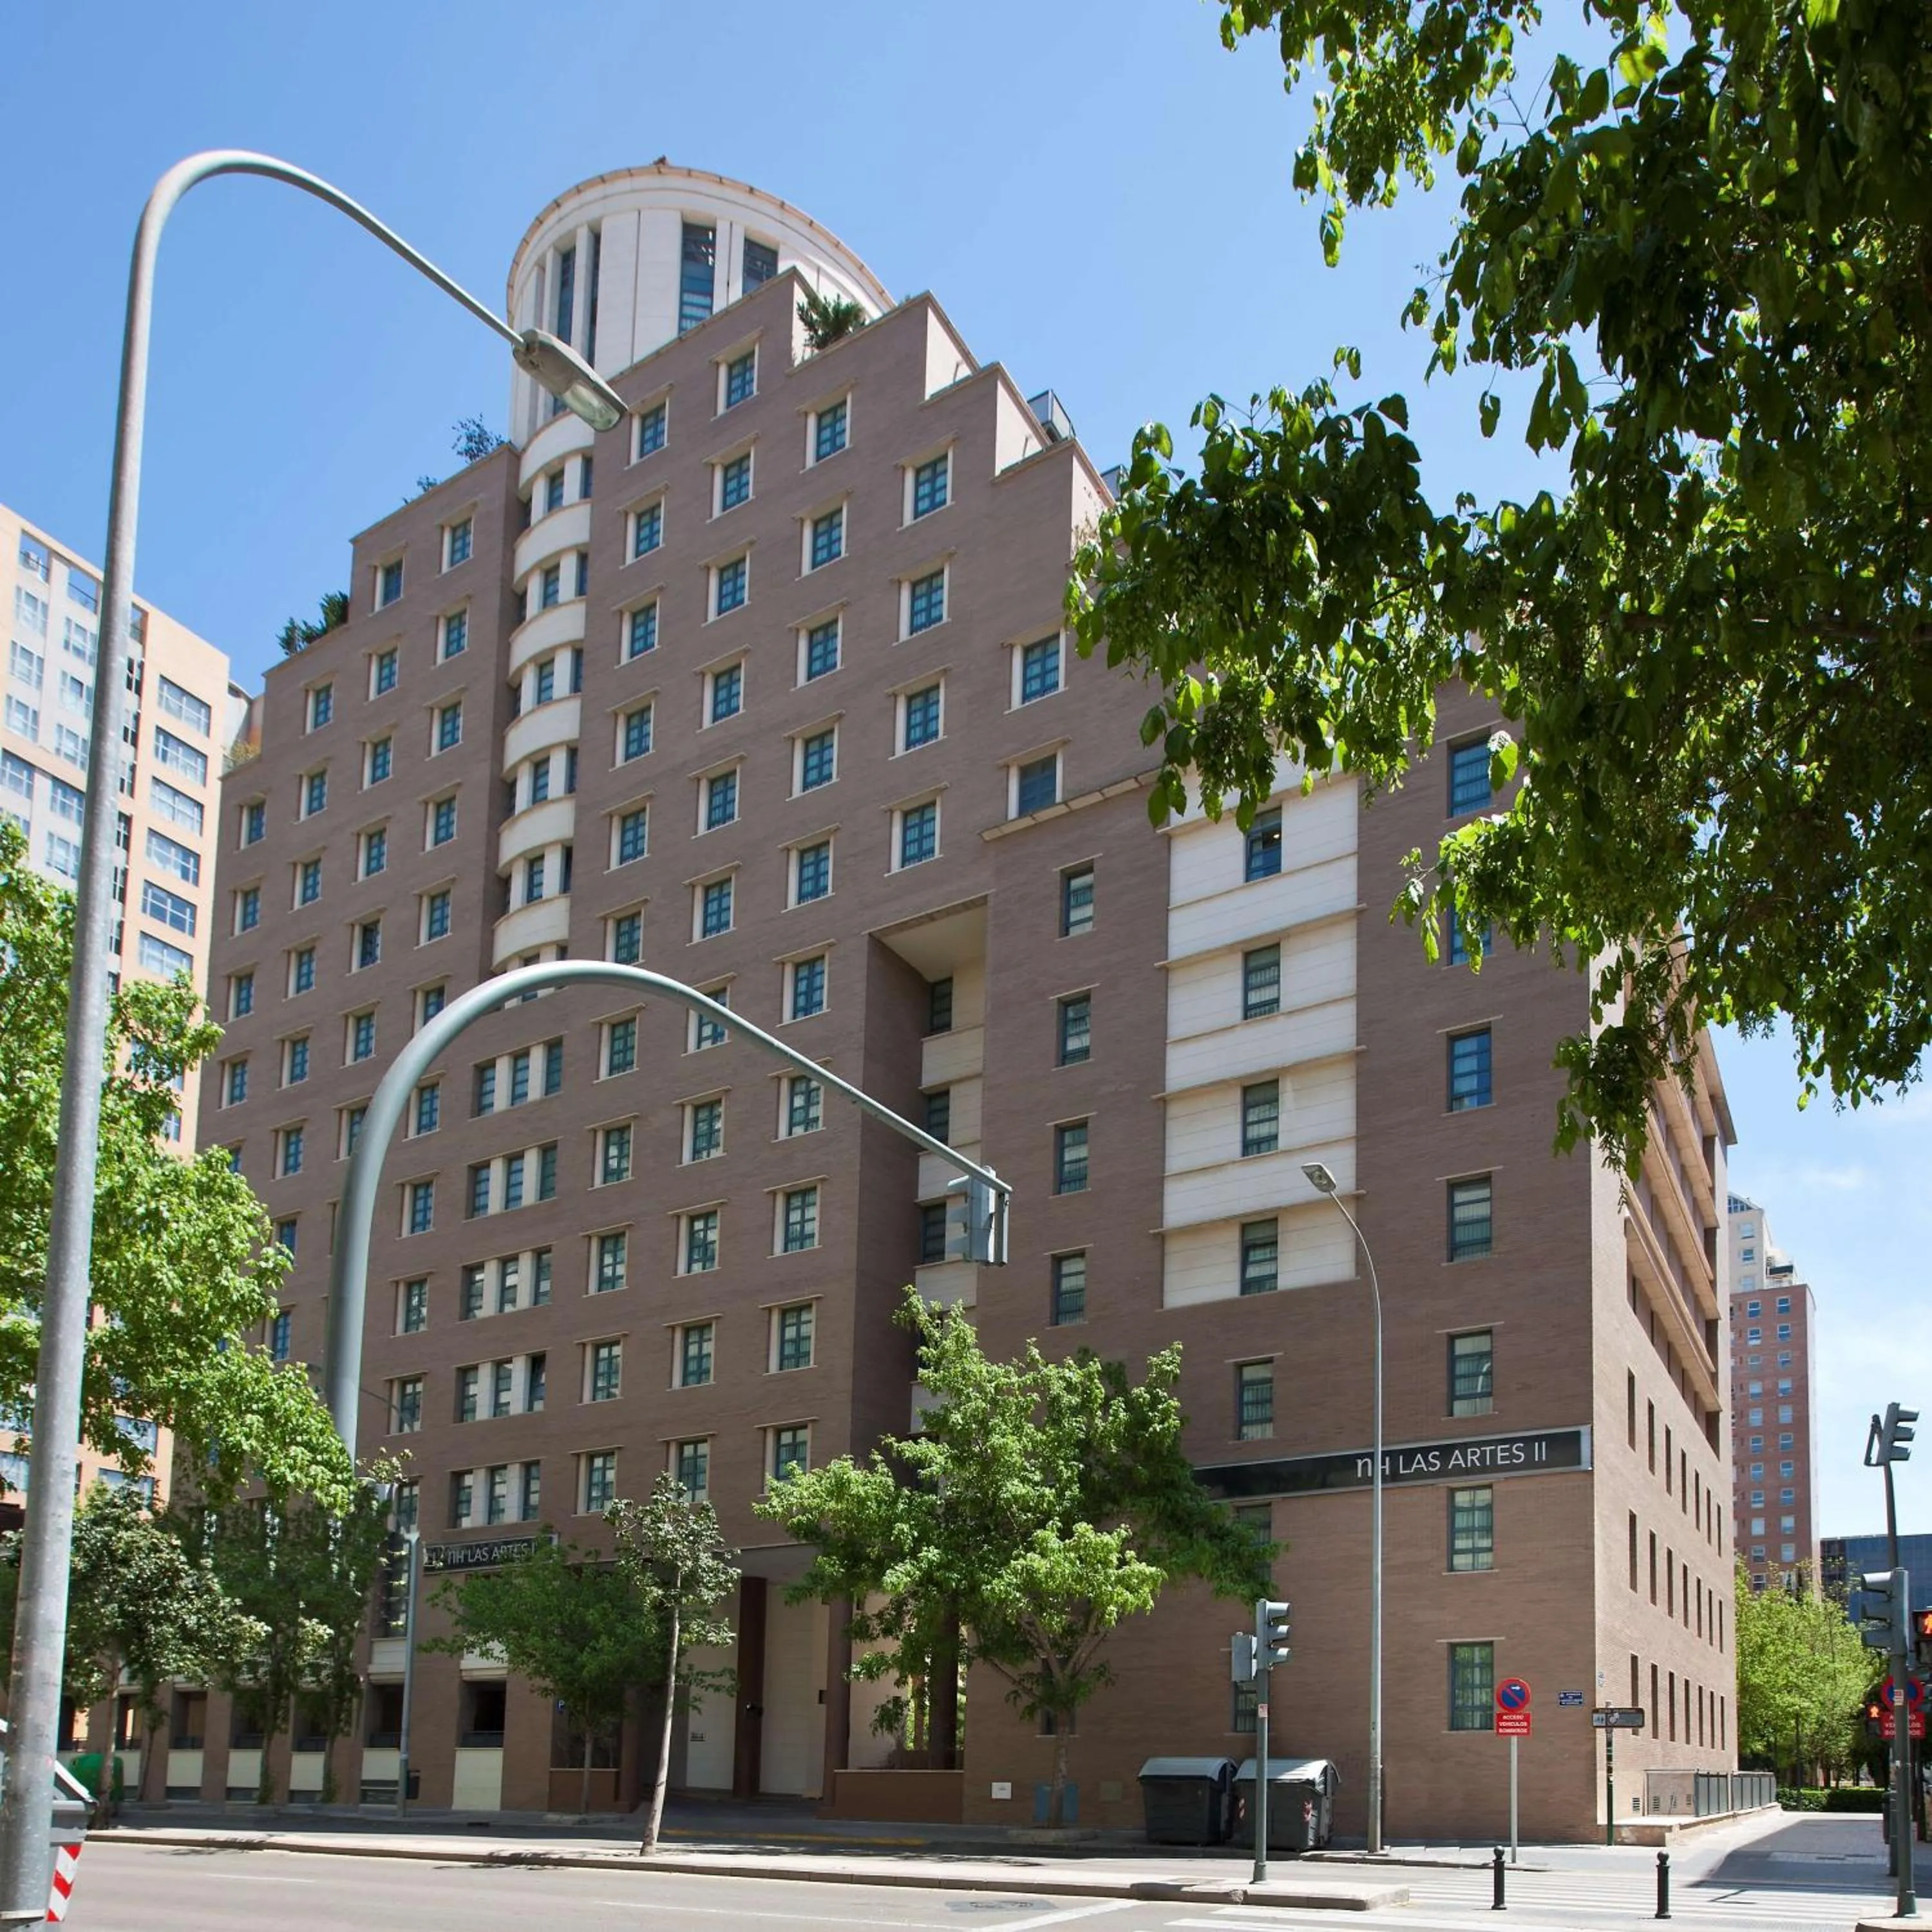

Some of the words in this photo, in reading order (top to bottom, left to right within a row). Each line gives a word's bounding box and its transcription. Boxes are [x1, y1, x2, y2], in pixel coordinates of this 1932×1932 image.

[1399, 1451, 1441, 1474] LAS
[1448, 1442, 1525, 1469] ARTES
[1535, 1441, 1546, 1461] II
[468, 1547, 489, 1562] LAS
[558, 1700, 565, 1709] P
